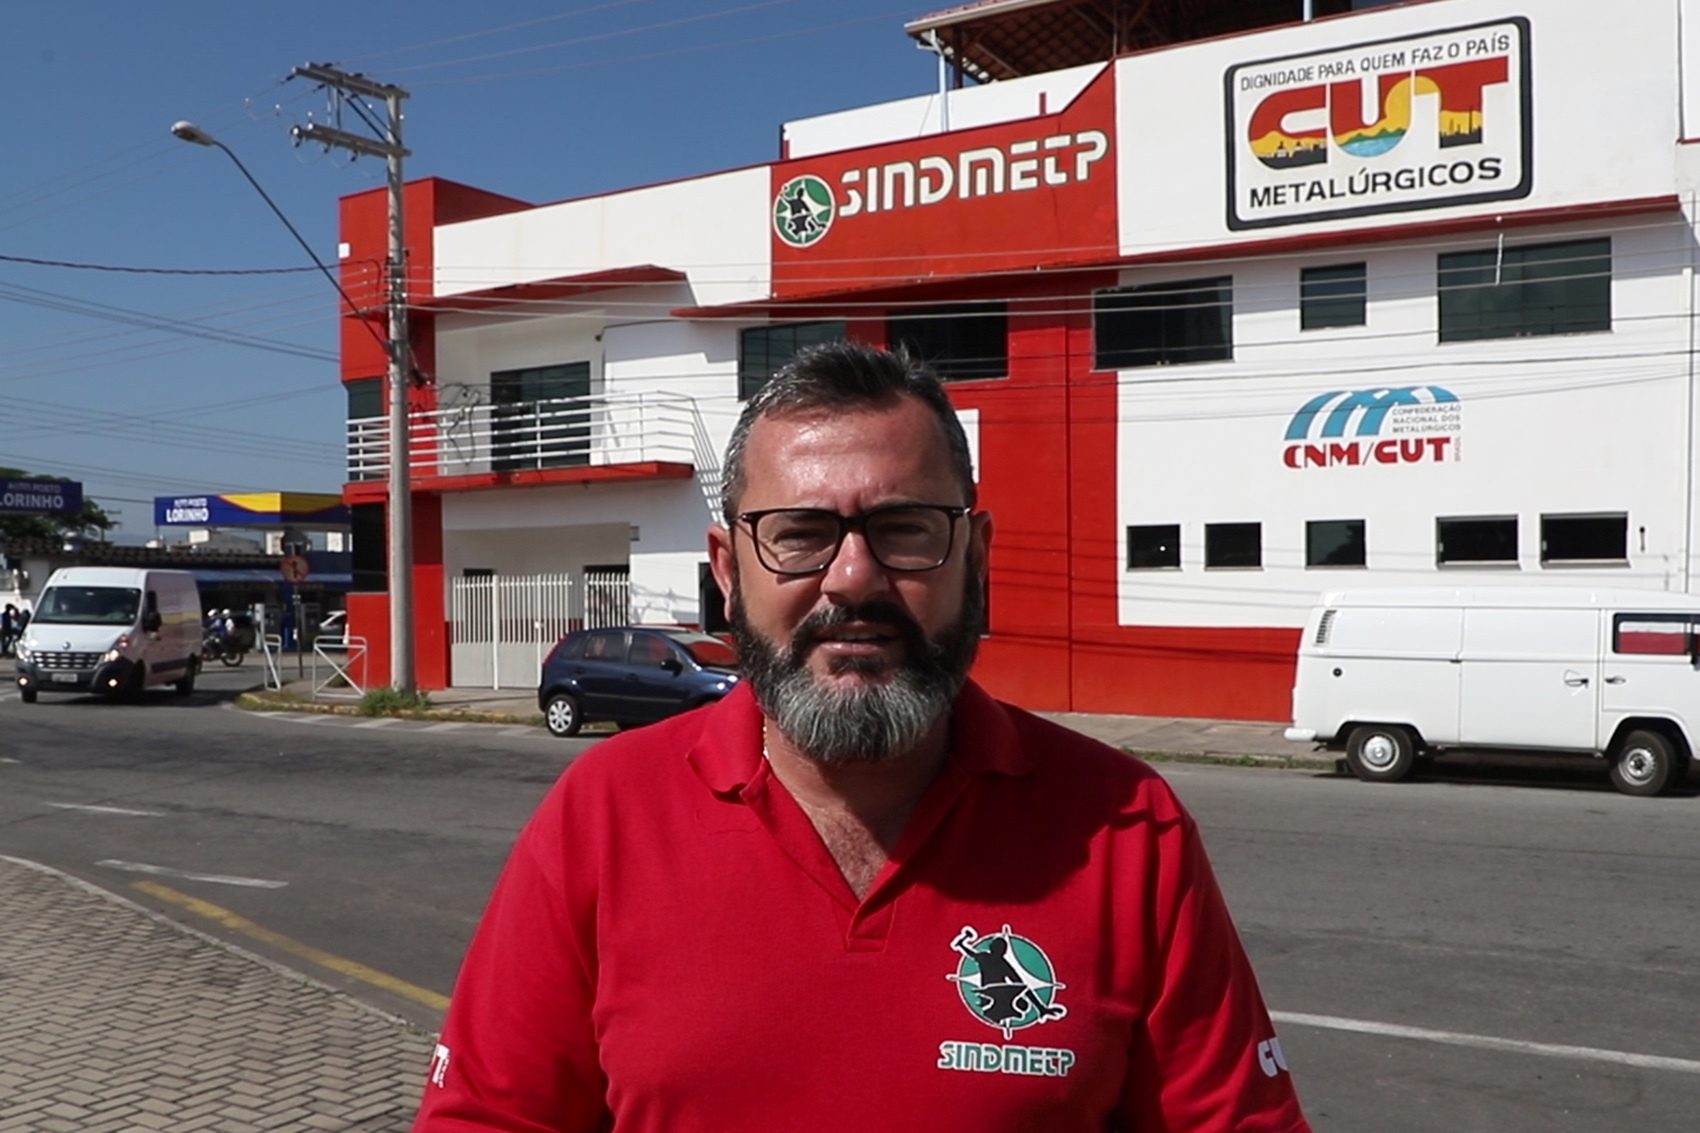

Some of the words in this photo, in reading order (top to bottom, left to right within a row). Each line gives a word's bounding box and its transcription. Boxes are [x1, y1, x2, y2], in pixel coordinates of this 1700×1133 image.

[1240, 66, 1315, 91] DIGNIDADE
[1318, 59, 1356, 79] PARA
[1360, 51, 1406, 71] QUEM
[1411, 45, 1443, 64] FAZ
[1447, 42, 1460, 58] O
[1465, 32, 1510, 56] PAÍS
[1247, 55, 1509, 170] CUT
[838, 130, 1109, 217] SINDMETP
[1249, 157, 1502, 208] METALÚRGICOS
[1392, 404, 1461, 416] CONFEDERAÇÃO
[1393, 416, 1438, 424] NACIONAL
[166, 507, 209, 522] LORINHO
[938, 1040, 1075, 1077] SINDMETP
